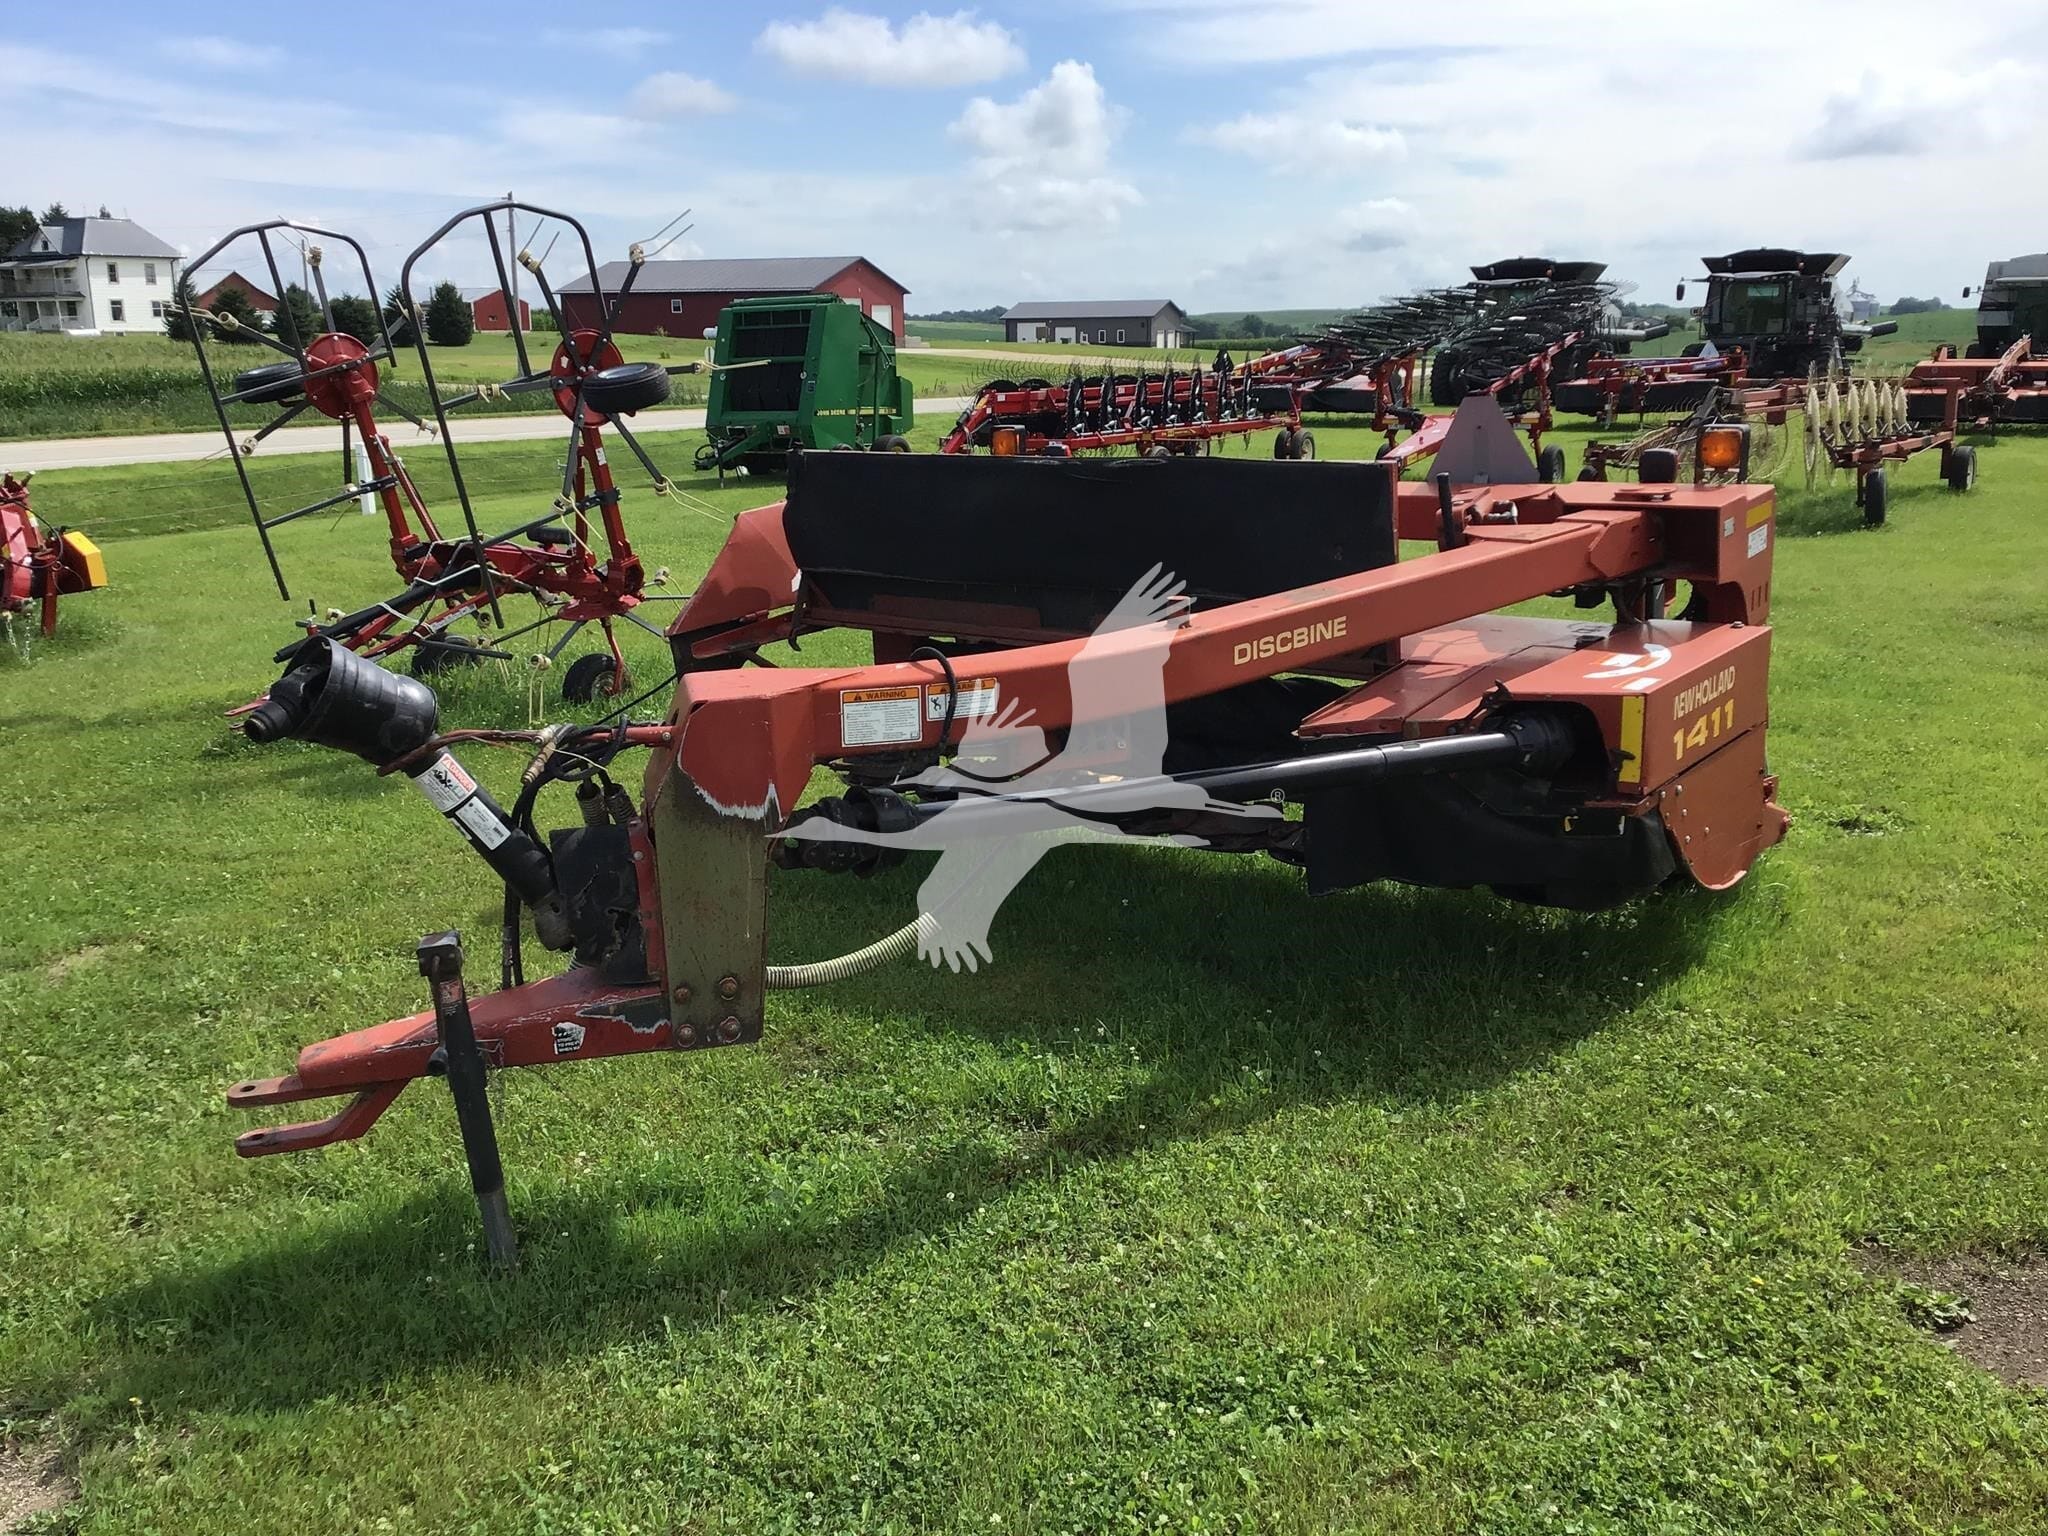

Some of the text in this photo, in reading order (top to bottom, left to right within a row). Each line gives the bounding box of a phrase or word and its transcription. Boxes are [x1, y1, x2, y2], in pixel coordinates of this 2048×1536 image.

[816, 408, 846, 417] JOHN DEERE
[1233, 615, 1348, 666] DISCBINE
[865, 690, 907, 700] WARNING
[1673, 665, 1737, 721] NEW HOLLAND
[1673, 698, 1735, 761] 1411
